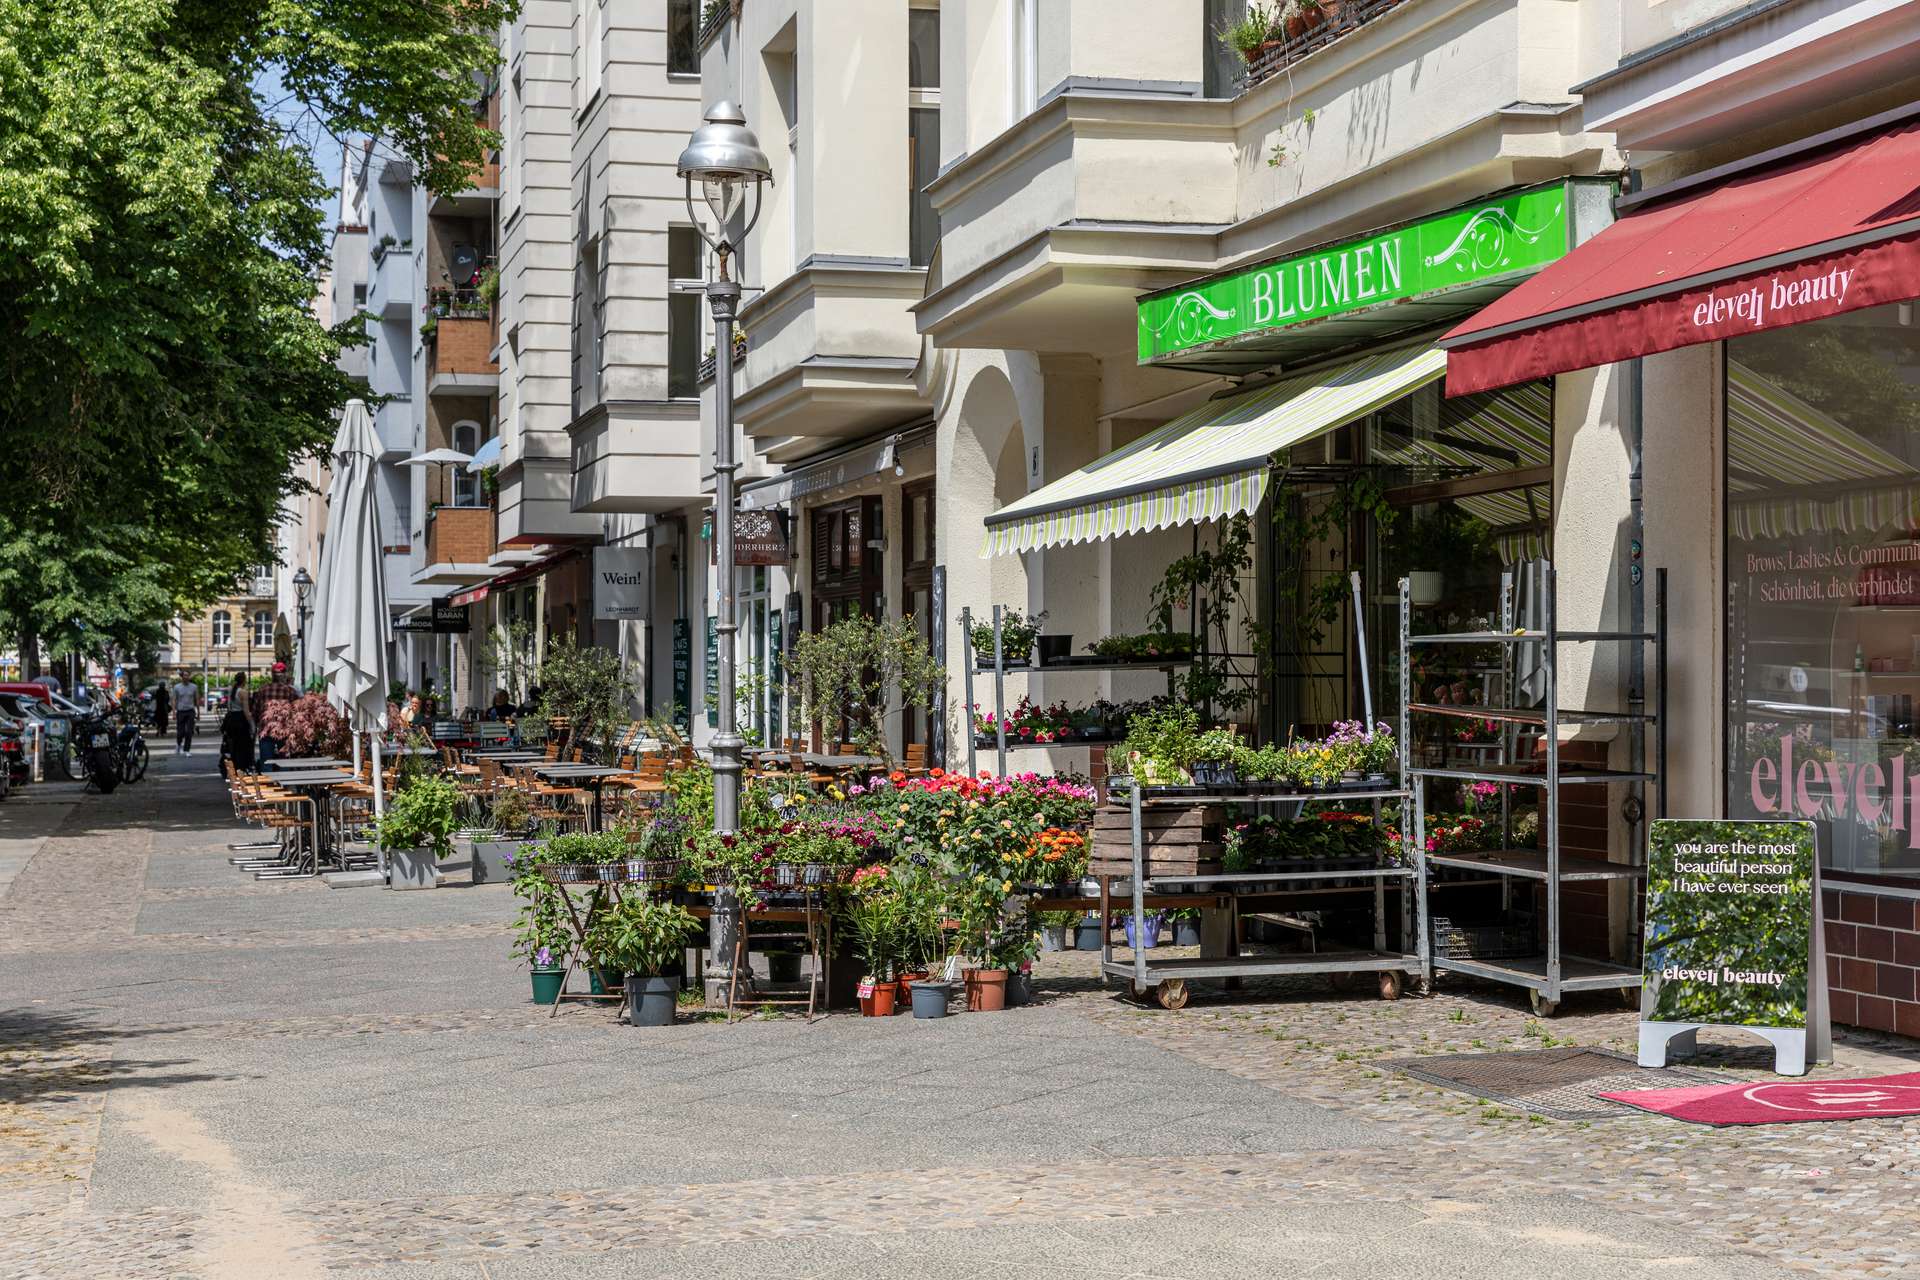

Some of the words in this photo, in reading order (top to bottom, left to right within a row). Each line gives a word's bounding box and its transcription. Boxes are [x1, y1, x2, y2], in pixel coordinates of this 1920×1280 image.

[1253, 238, 1401, 324] BLUMEN
[1770, 265, 1855, 311] beauty
[734, 543, 785, 551] DERHERZ
[1747, 552, 1787, 574] Brows,
[1788, 546, 1831, 570] Lashes
[1833, 546, 1847, 567] &
[601, 571, 641, 585] Wein!
[1760, 577, 1825, 602] Schönheit,
[1827, 575, 1848, 599] die
[1849, 571, 1914, 597] verbindet
[1674, 843, 1701, 856] you
[1704, 843, 1729, 855] are
[1731, 840, 1756, 854] the
[1758, 843, 1797, 855] most
[1674, 859, 1737, 874] beautiful
[1740, 863, 1793, 878] person
[1673, 879, 1678, 892] I
[1682, 879, 1715, 893] have
[1718, 882, 1750, 893] ever
[1753, 882, 1788, 894] seen
[1723, 967, 1786, 989] beauty
